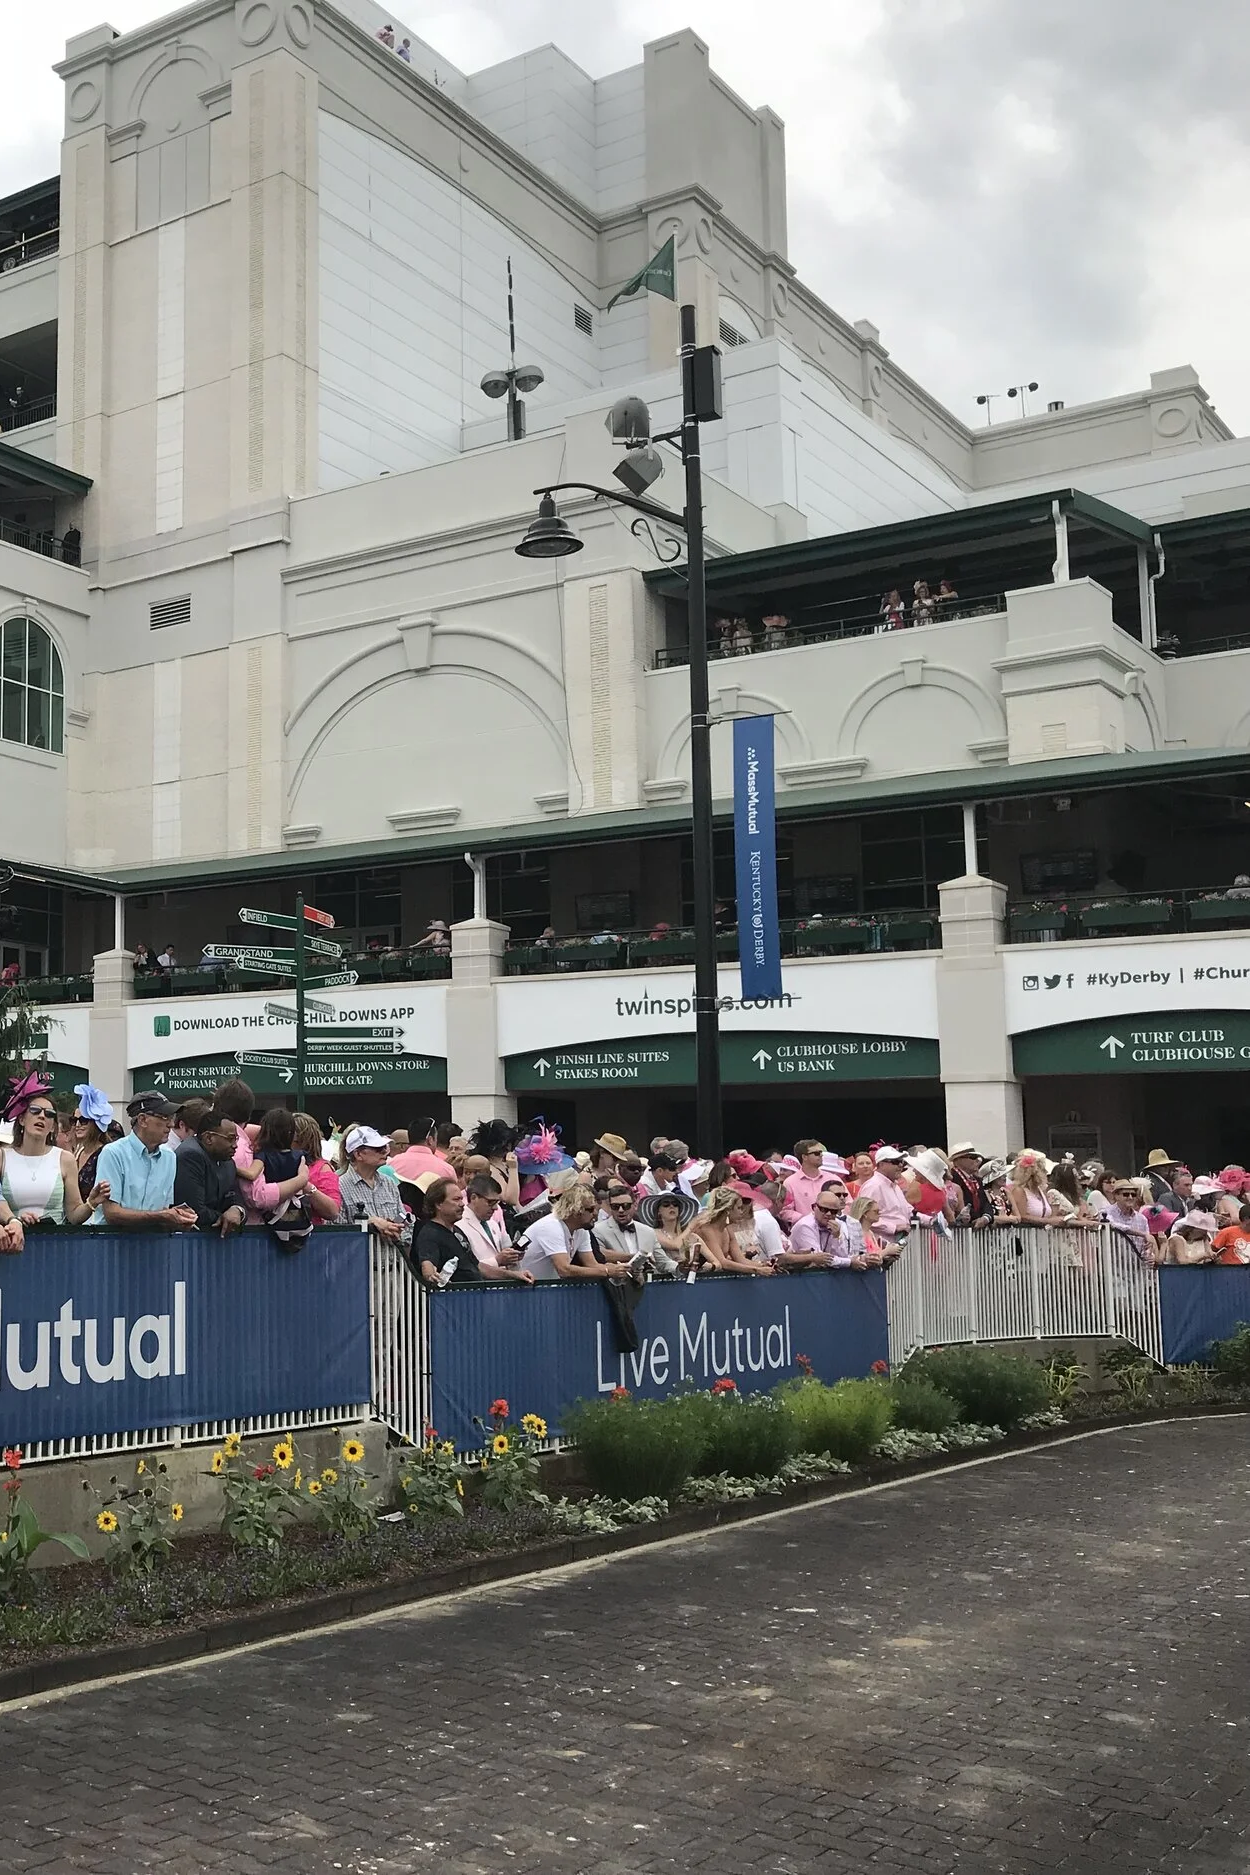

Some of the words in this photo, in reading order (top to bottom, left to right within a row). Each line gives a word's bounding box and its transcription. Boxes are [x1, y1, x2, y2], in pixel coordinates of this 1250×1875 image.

[747, 760, 760, 835] MassMutual
[750, 850, 762, 914] KENTUCKY
[247, 912, 268, 923] INFIELD
[215, 947, 274, 958] GRANDSTAND
[753, 930, 765, 966] DERBY
[244, 960, 265, 969] STARTING
[265, 962, 277, 970] GATE
[324, 975, 350, 986] PADDOCK
[1086, 969, 1171, 988] #KyDerby
[1193, 966, 1250, 980] #Chur
[174, 1017, 239, 1031] DOWNLOAD
[242, 1016, 264, 1027] THE
[339, 1008, 387, 1022] DOWNS
[390, 1007, 415, 1020] APP
[372, 1028, 392, 1037] EXIT
[1130, 1031, 1174, 1044] TURF
[1178, 1030, 1225, 1043] CLUB
[776, 1042, 859, 1057] CLUBHOUSE
[862, 1041, 908, 1053] LOBBY
[1132, 1046, 1235, 1062] CLUBHOUSE
[244, 1054, 261, 1063] JOCKEY
[262, 1056, 273, 1064] CLUB
[273, 1057, 289, 1065] SUITES
[555, 1054, 593, 1065] FINISH
[597, 1053, 624, 1064] LINE
[627, 1051, 669, 1063] SUITES
[168, 1067, 197, 1077] GUEST
[198, 1066, 241, 1076] SERVICES
[304, 1063, 353, 1073] HURCHILL
[356, 1061, 393, 1072] DOWNS
[395, 1060, 430, 1070] STORE
[777, 1061, 795, 1073] US
[798, 1059, 835, 1072] BANK
[555, 1068, 598, 1079] STAKES
[601, 1067, 638, 1078] ROOM
[168, 1079, 217, 1089] PROGRAMS
[304, 1076, 345, 1086] ADDOCK
[347, 1075, 373, 1085] GATE
[597, 1320, 669, 1392] Live
[679, 1305, 791, 1381] Mutual
